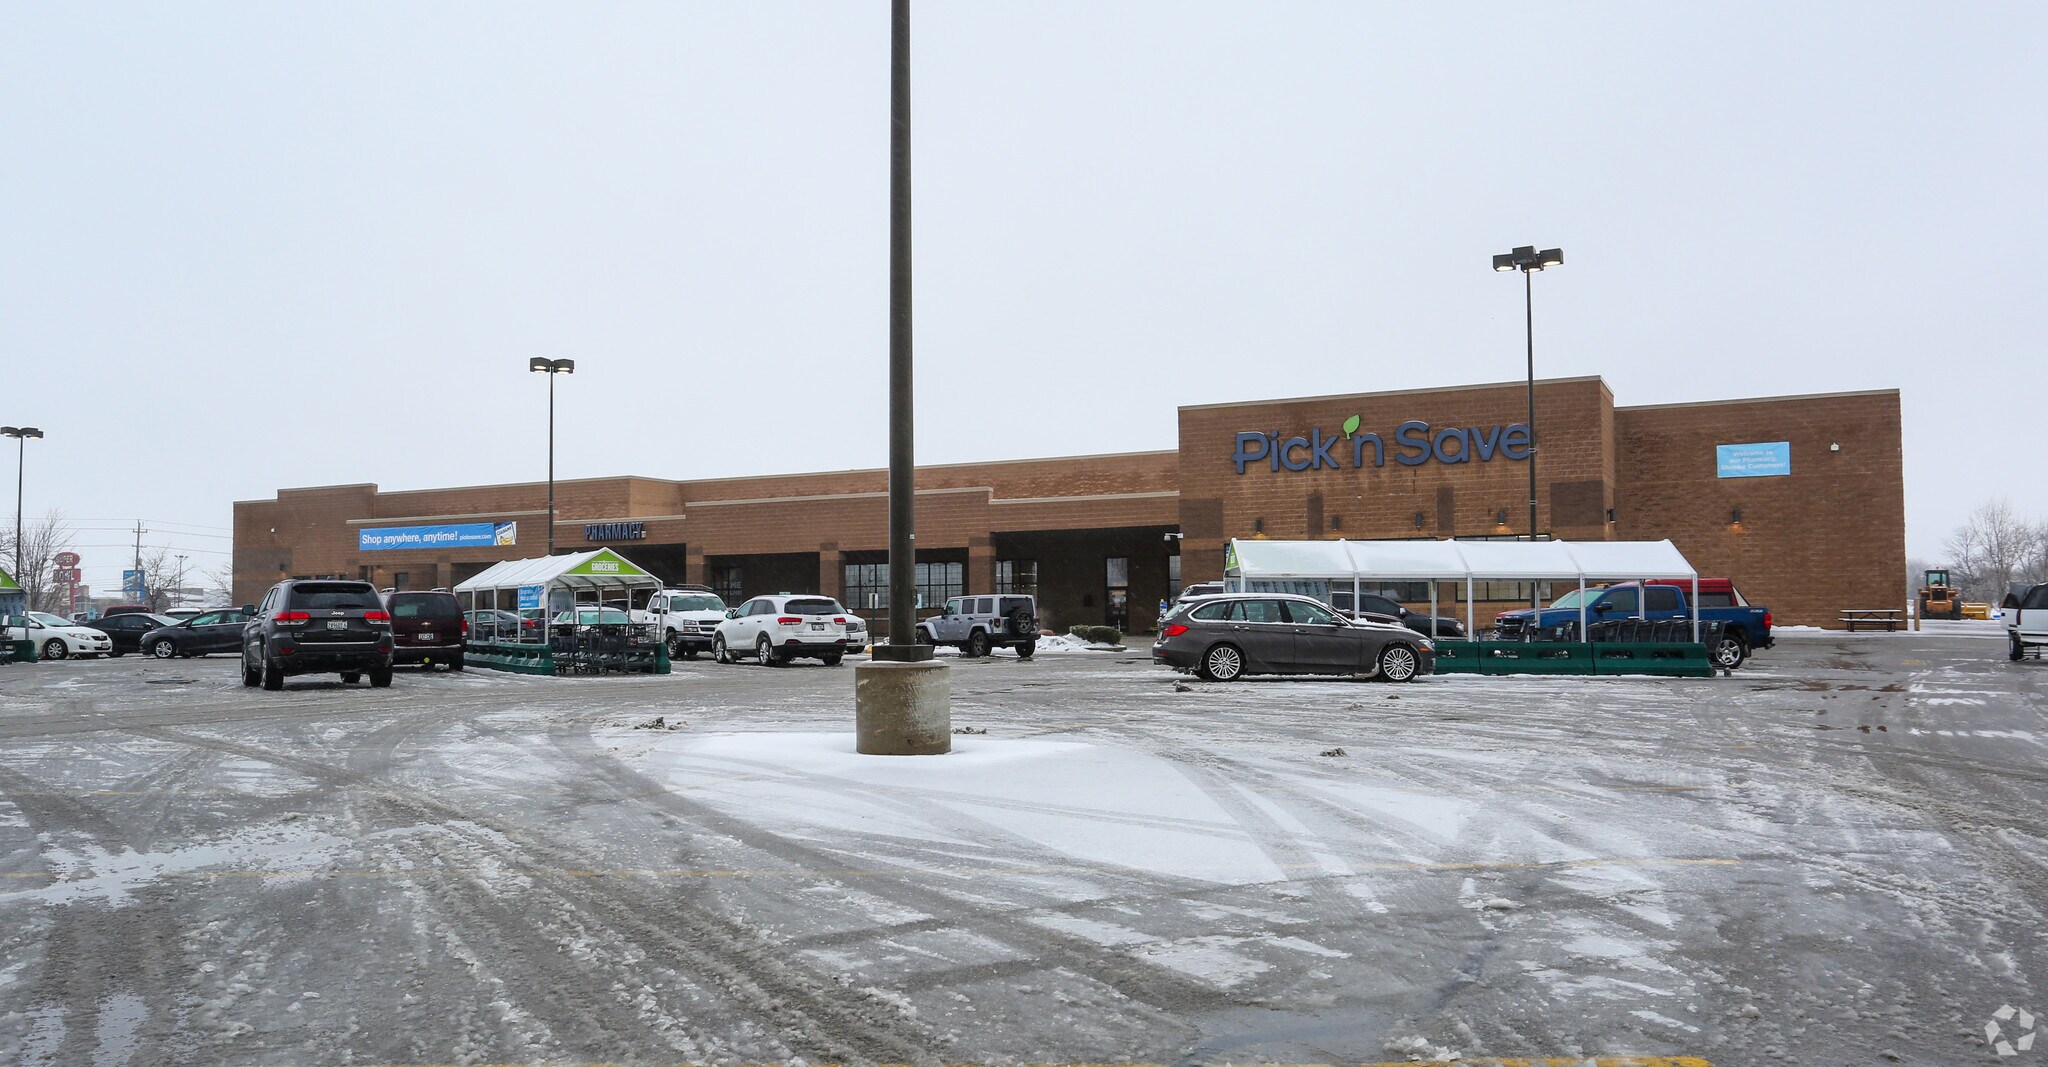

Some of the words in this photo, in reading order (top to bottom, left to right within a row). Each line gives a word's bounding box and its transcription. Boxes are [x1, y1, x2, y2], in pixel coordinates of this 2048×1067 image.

[1232, 427, 1340, 475] Pick
[1394, 420, 1531, 467] Save
[361, 534, 382, 545] Shop
[383, 532, 422, 544] anywhere,
[423, 531, 458, 543] anytime!
[585, 521, 643, 541] PHARMACY
[591, 562, 619, 571] GROCERIES
